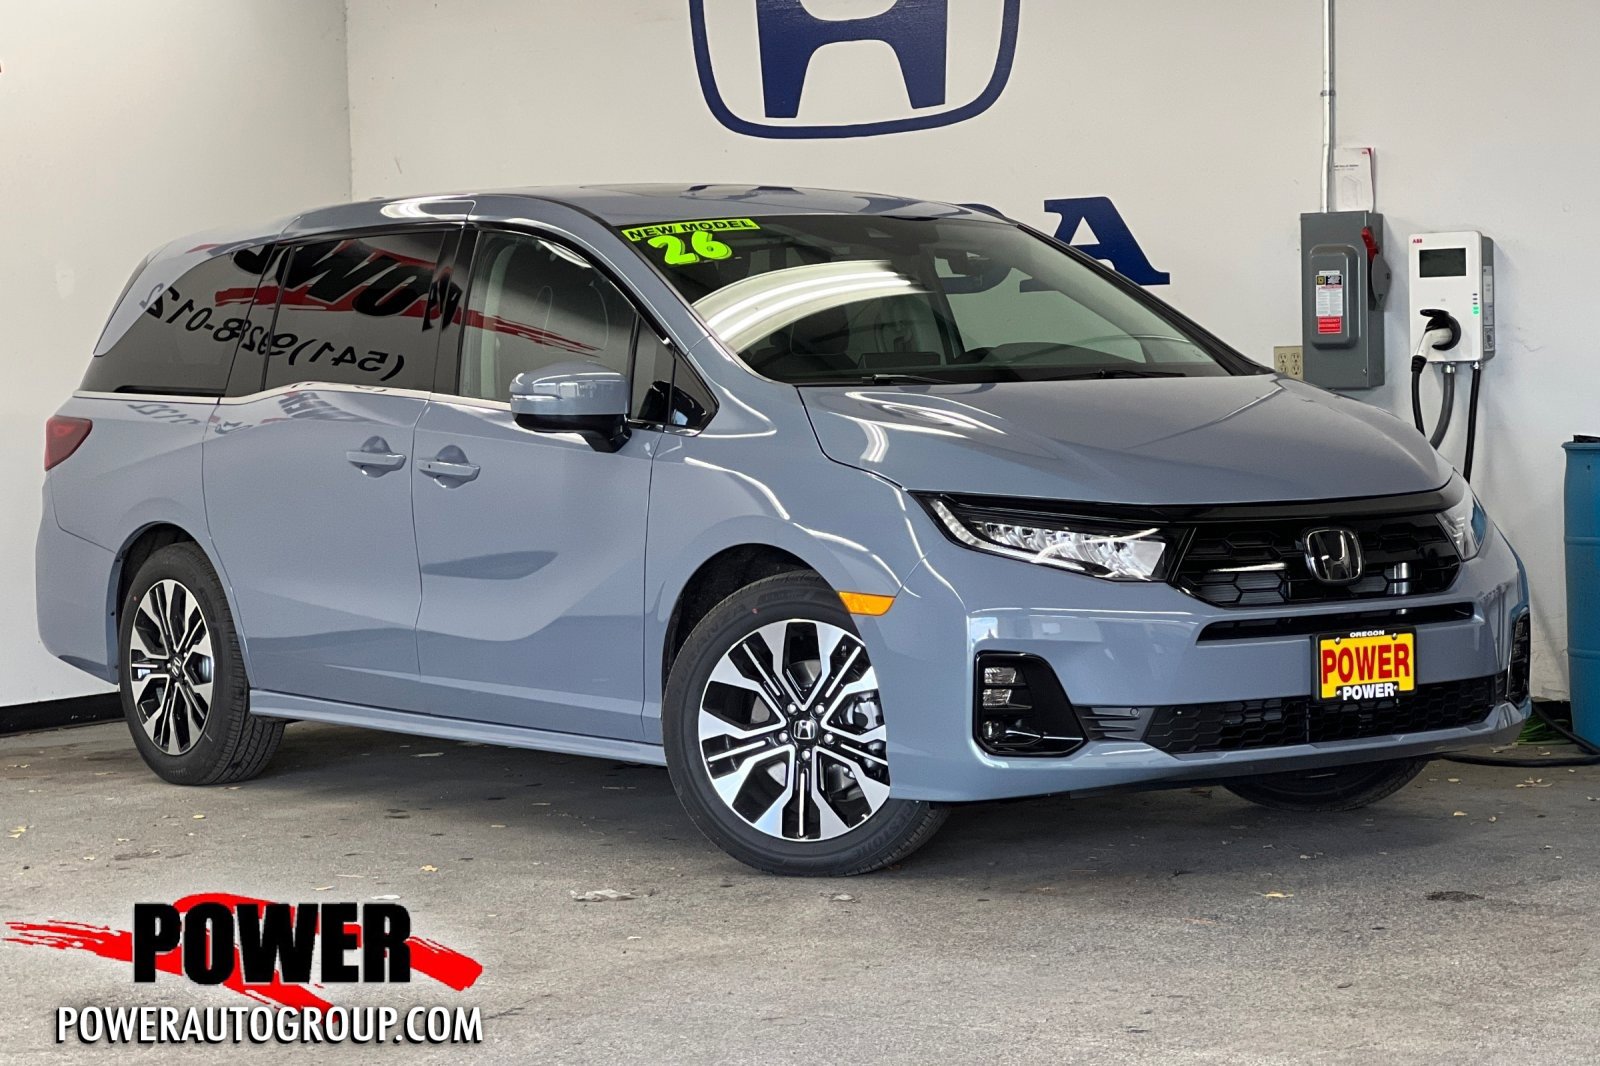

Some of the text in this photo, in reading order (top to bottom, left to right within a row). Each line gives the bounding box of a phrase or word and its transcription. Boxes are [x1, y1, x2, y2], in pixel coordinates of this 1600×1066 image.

[628, 220, 753, 239] NEW MODEL
[647, 230, 732, 265] 26
[1349, 629, 1385, 638] OREGON
[1322, 643, 1410, 684] POWER
[1342, 683, 1395, 700] POWER
